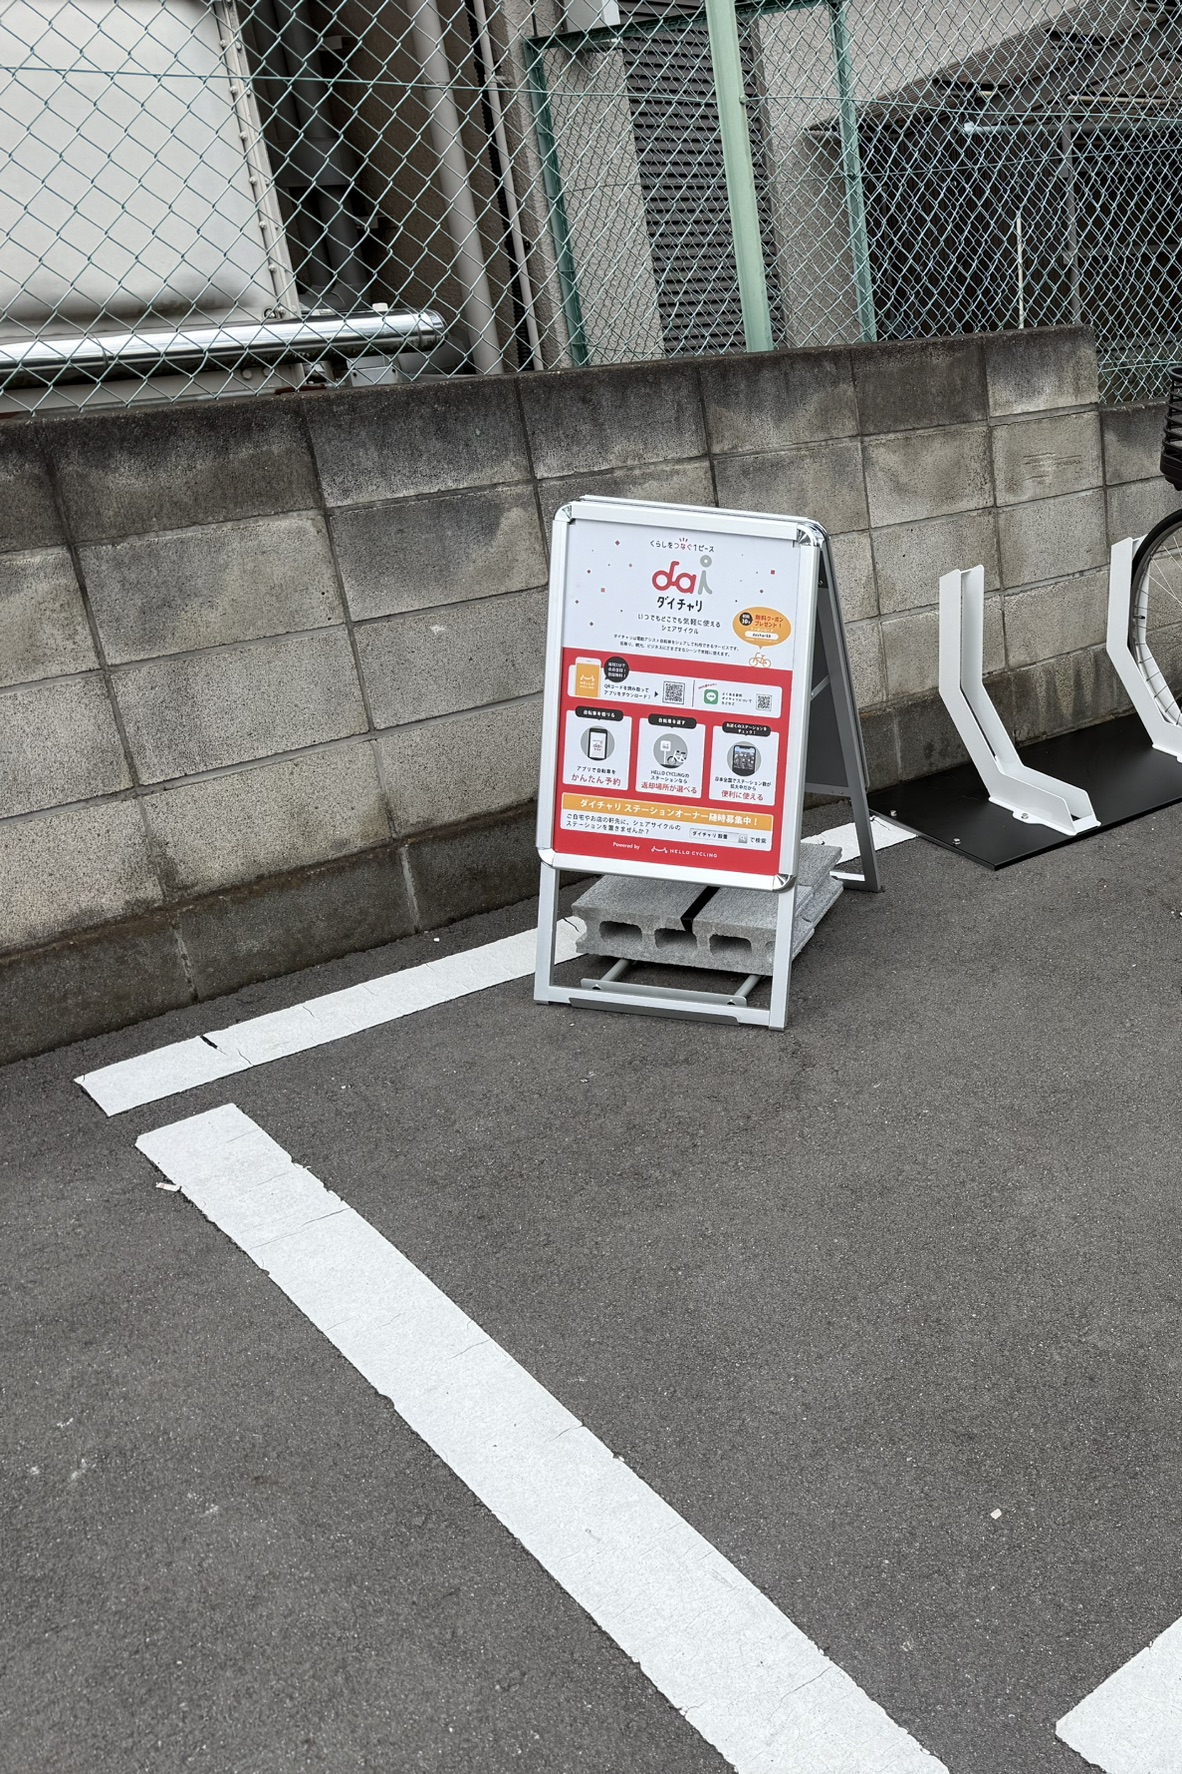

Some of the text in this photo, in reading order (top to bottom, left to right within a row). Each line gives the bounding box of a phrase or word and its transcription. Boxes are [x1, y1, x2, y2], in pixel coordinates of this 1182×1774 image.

[650, 540, 715, 553] くらしをつなぐ1ピース
[652, 554, 713, 595] dai
[657, 597, 703, 612] ダイチャリ
[638, 613, 720, 627] いつでもどこでも気軽に使える
[661, 625, 698, 633] シェアサイクル
[604, 684, 649, 692] QRコードを読み取って
[577, 765, 616, 774] アプリで自転車を
[572, 773, 621, 785] かんたん予約
[651, 774, 687, 783] ステーションなら
[642, 781, 697, 793] 返却場所が選べる
[721, 789, 763, 800] 便利に使える
[580, 798, 758, 825] ダイチャリ ステーションオーナー随時募集中!
[567, 812, 681, 830] ご自宅やお店の軒先に、シェアサイクルの
[567, 820, 649, 834] ステーションを置きませんか?
[692, 829, 715, 838] ダイチャリ
[692, 850, 717, 858] CYCLING
